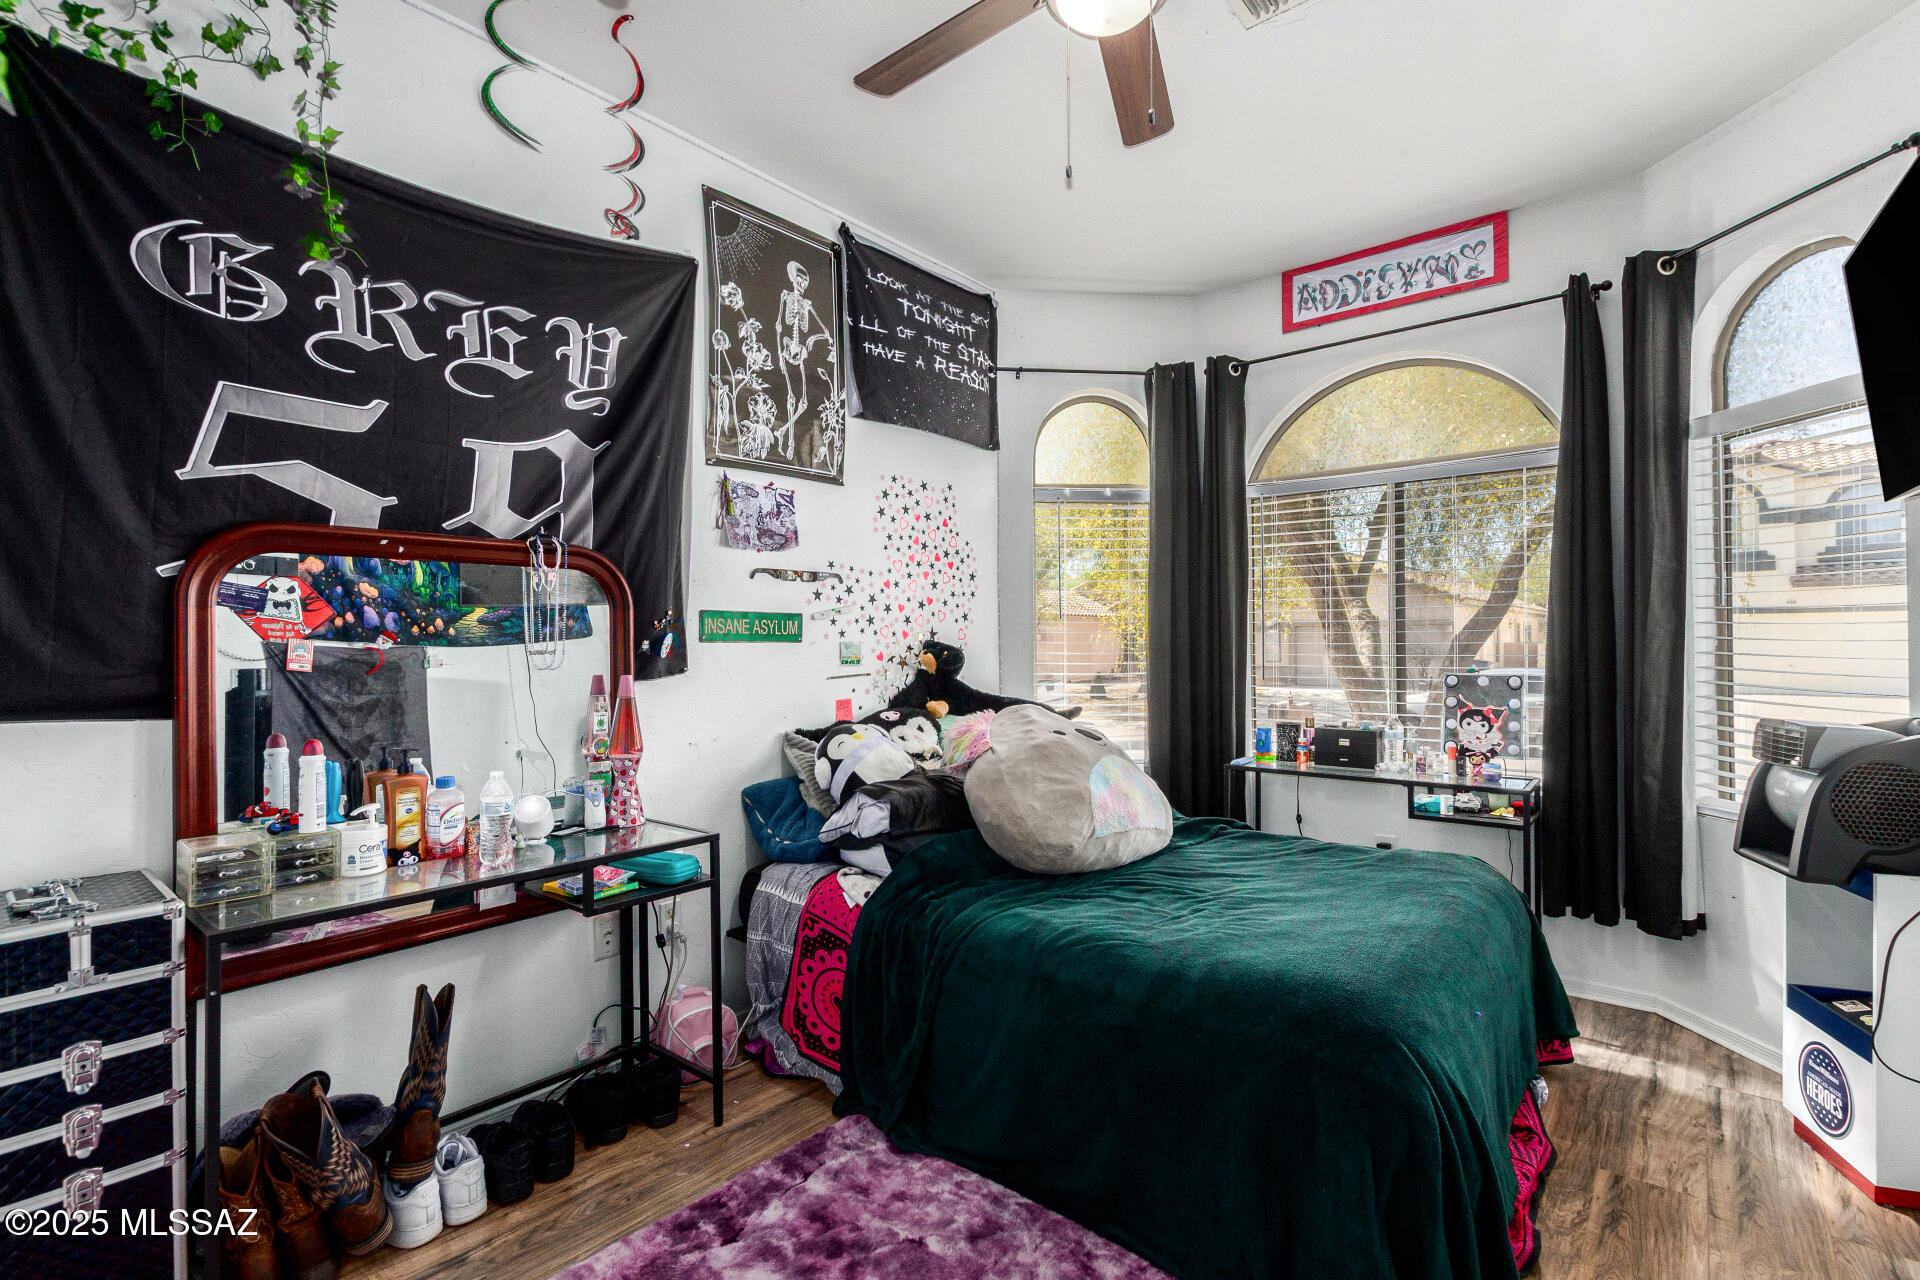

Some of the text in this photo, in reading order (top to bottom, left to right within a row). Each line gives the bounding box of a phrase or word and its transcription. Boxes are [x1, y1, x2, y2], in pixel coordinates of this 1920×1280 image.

[129, 219, 628, 415] GREY
[867, 268, 990, 329] LOOK AT THE SKY
[896, 298, 976, 343] TONIGHT
[896, 326, 917, 340] OF
[924, 335, 951, 354] THE
[863, 341, 990, 396] HAVE A REASON
[704, 617, 799, 636] INSANE ASYLUM
[1806, 1075, 1844, 1120] HEROES
